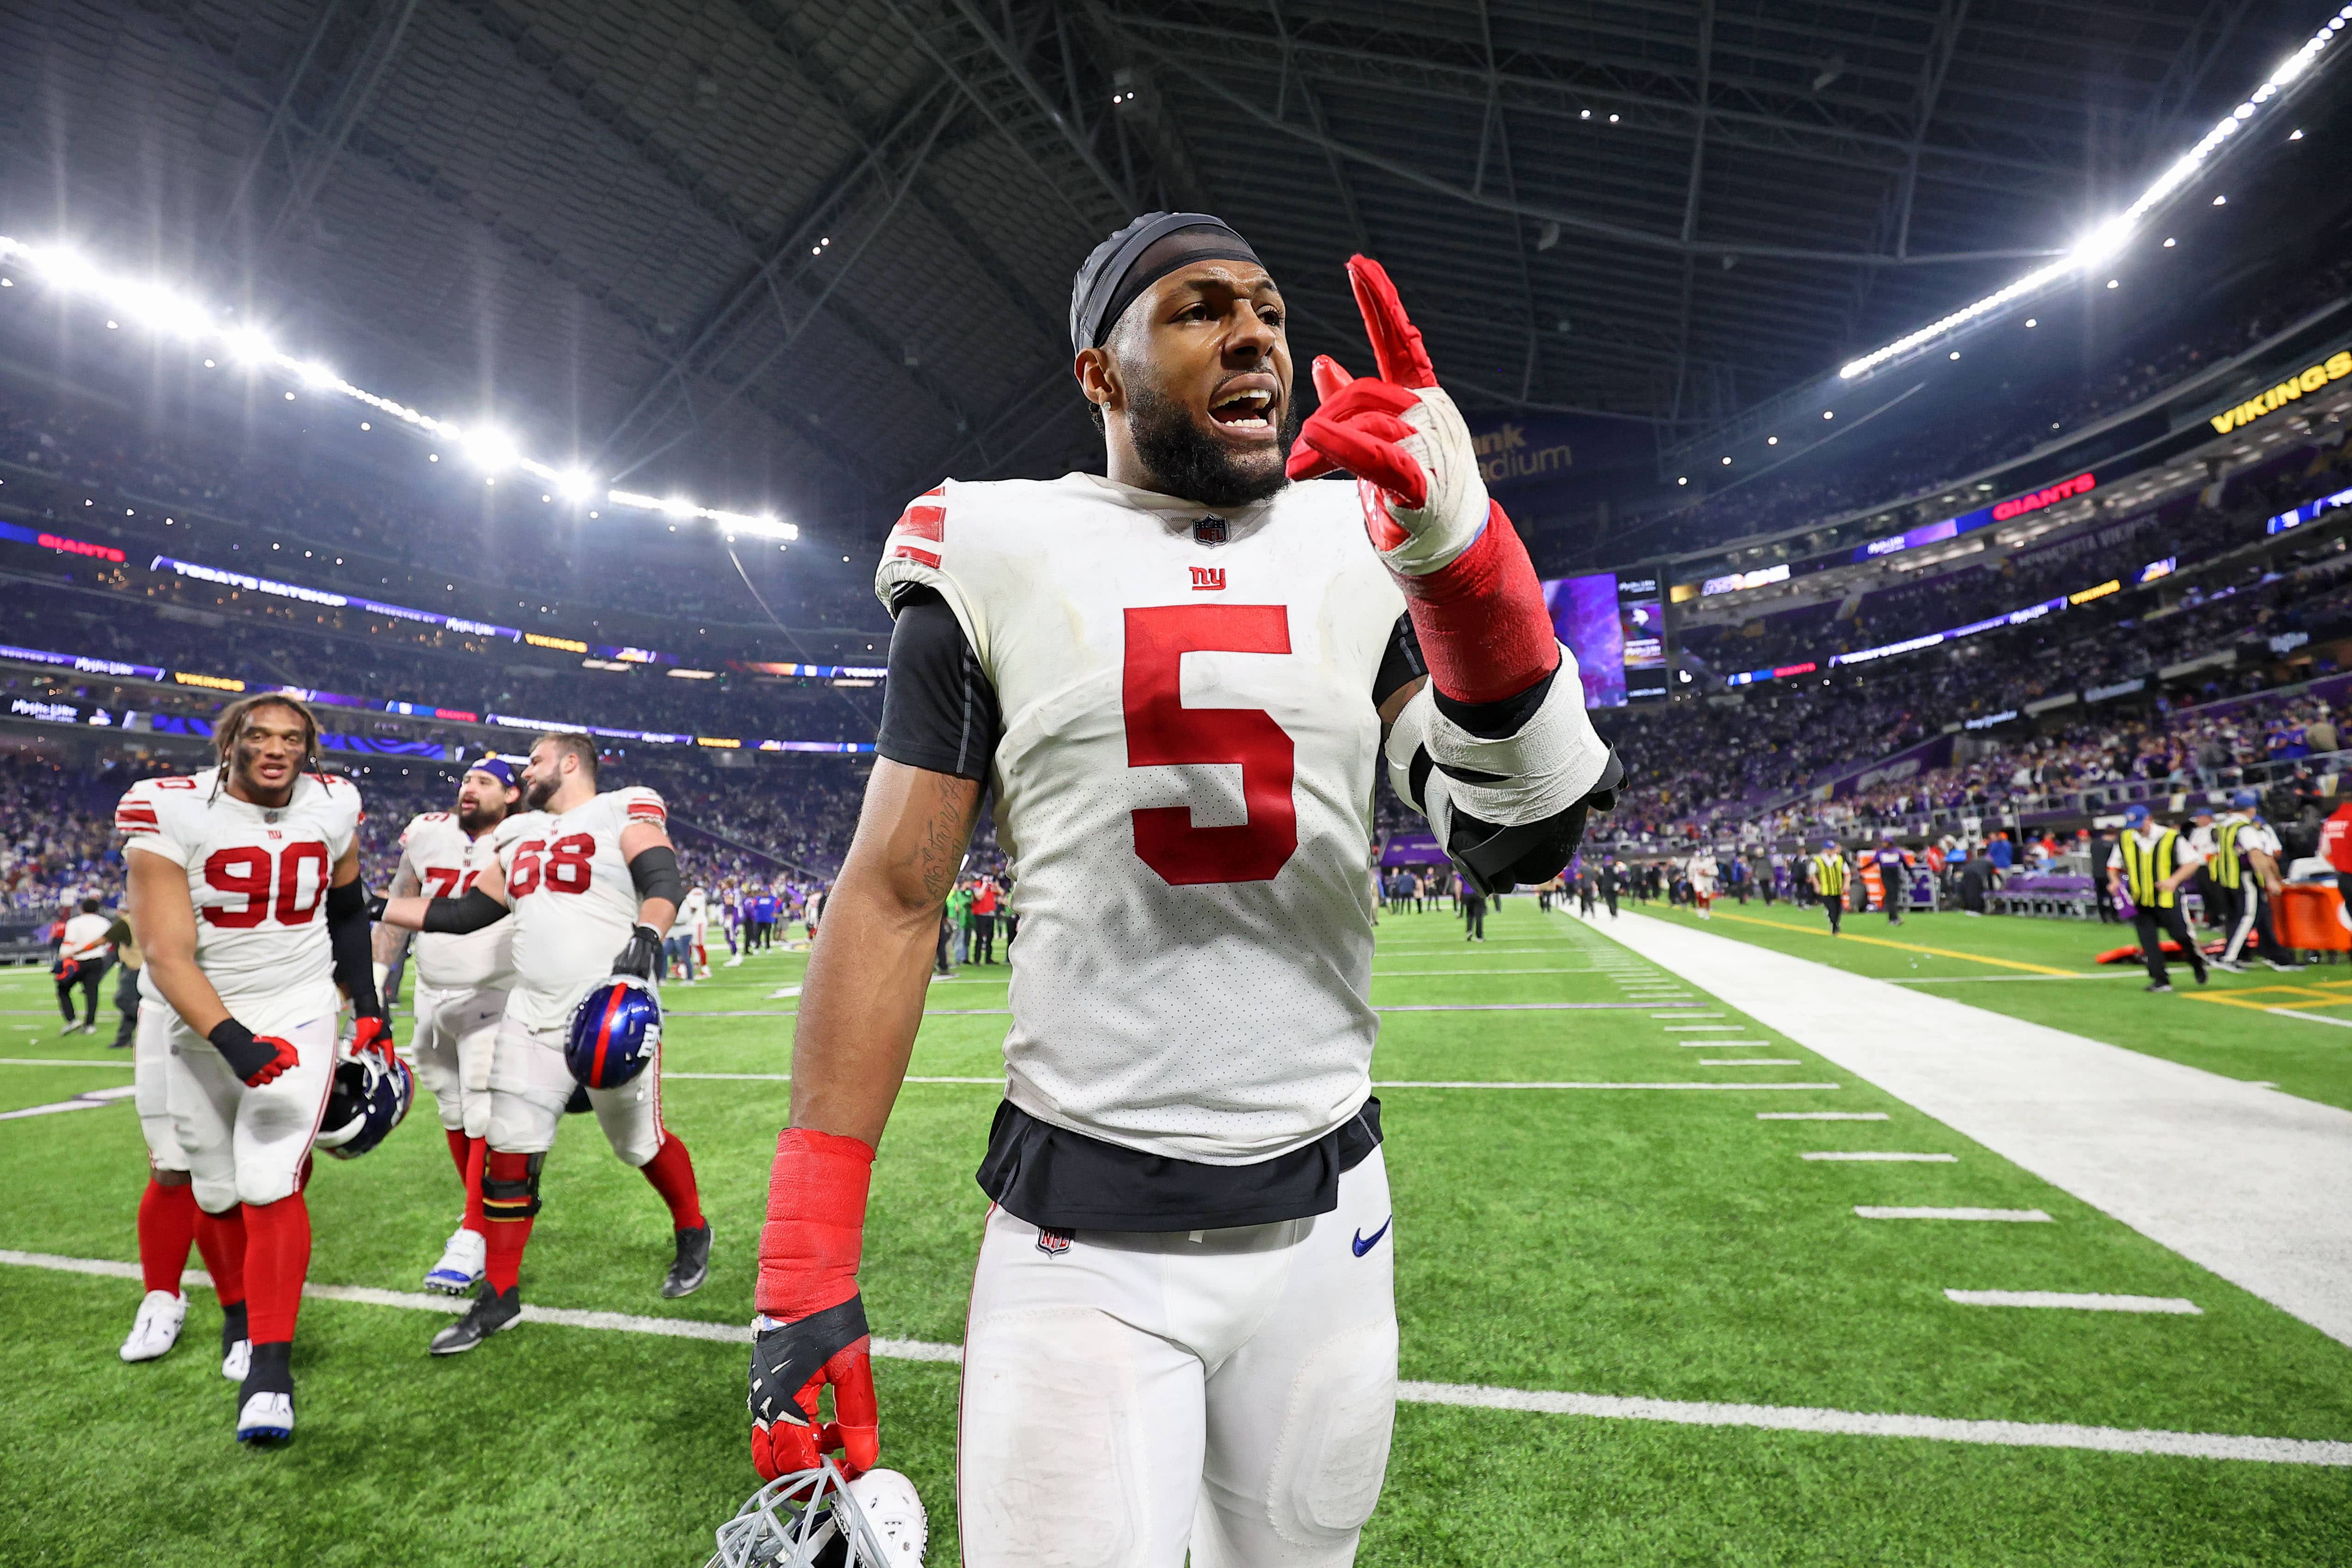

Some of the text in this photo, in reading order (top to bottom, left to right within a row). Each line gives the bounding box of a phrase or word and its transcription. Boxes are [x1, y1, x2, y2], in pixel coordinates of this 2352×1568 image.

[2210, 350, 2352, 435] VIKINGS
[1992, 472, 2096, 521] GIANTS
[37, 533, 125, 562] GIANTS
[525, 632, 588, 654] VIKINGS
[174, 671, 245, 692] VIKINGS
[843, 667, 888, 678] TODAY
[1123, 604, 1298, 886] 5
[202, 842, 333, 929] 90
[508, 833, 596, 900] 68
